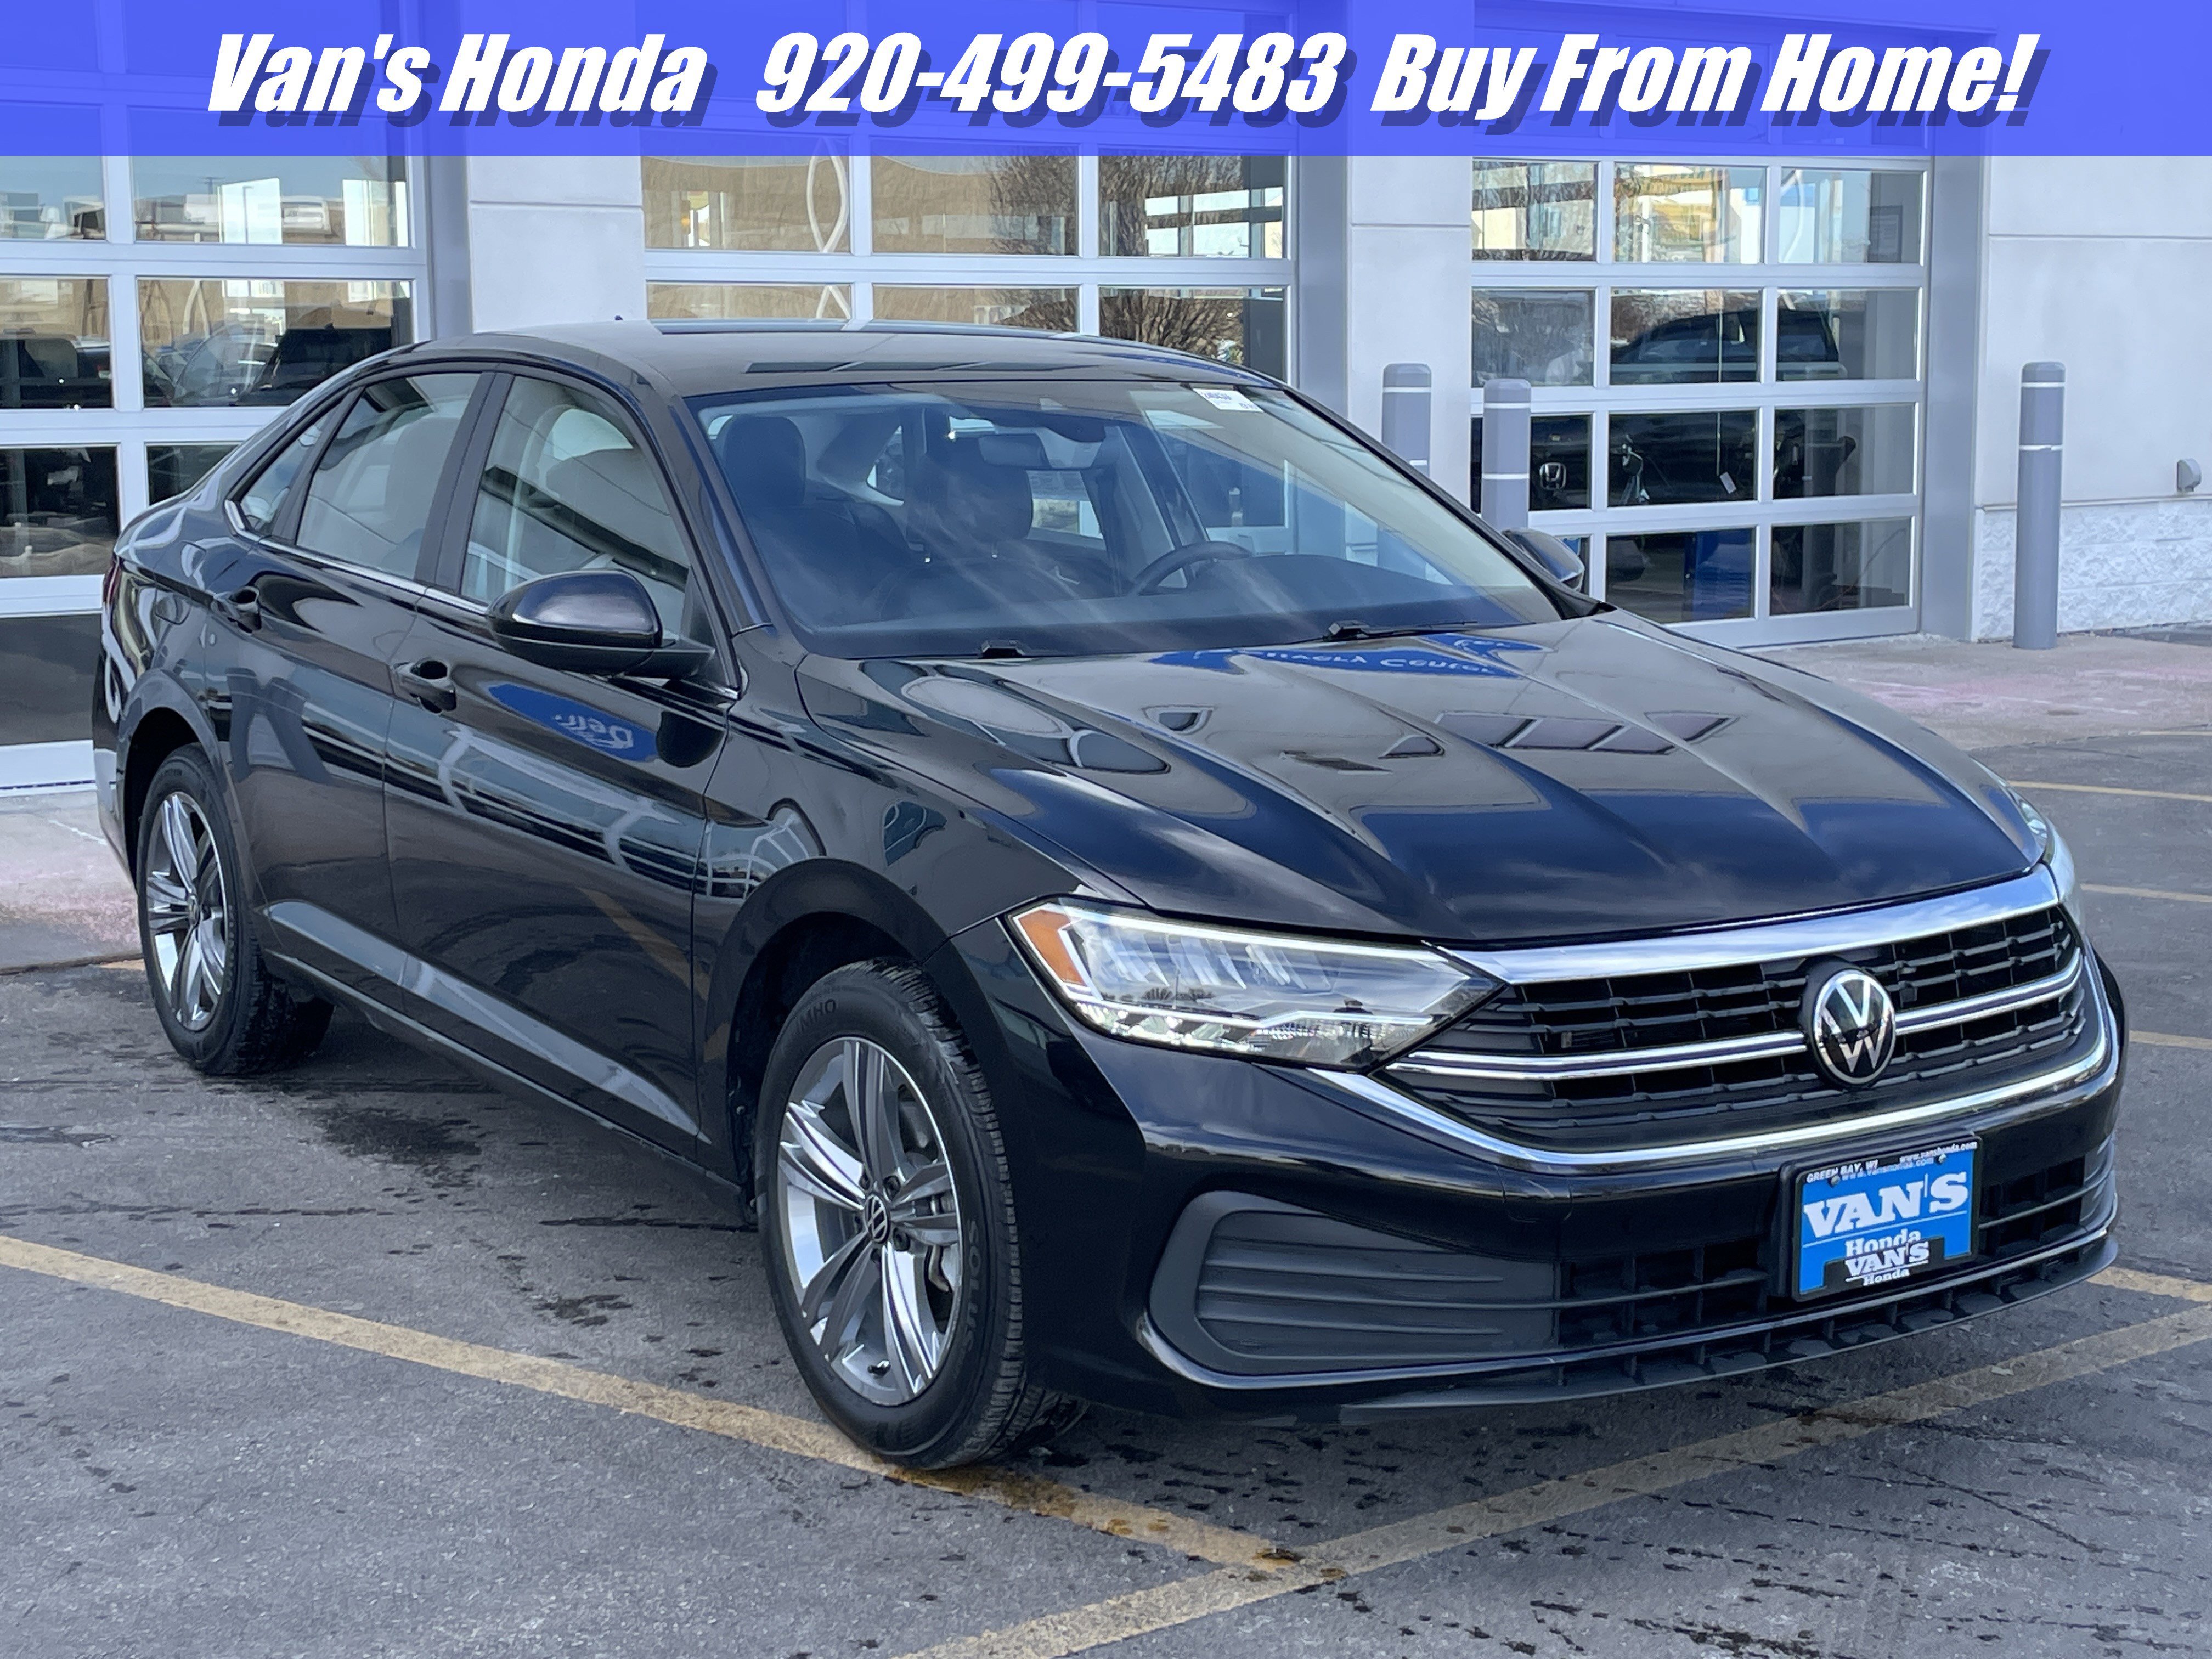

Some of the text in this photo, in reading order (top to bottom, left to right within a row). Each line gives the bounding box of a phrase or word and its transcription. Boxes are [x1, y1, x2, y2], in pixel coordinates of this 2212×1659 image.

[1805, 1167, 1838, 1184] GREEN
[1866, 1158, 1879, 1171] WI
[1803, 1171, 1968, 1238] VAN'S
[1845, 1228, 1922, 1257] Honda
[1845, 1240, 1929, 1277] VAN'S
[1863, 1267, 1910, 1286] Honda
